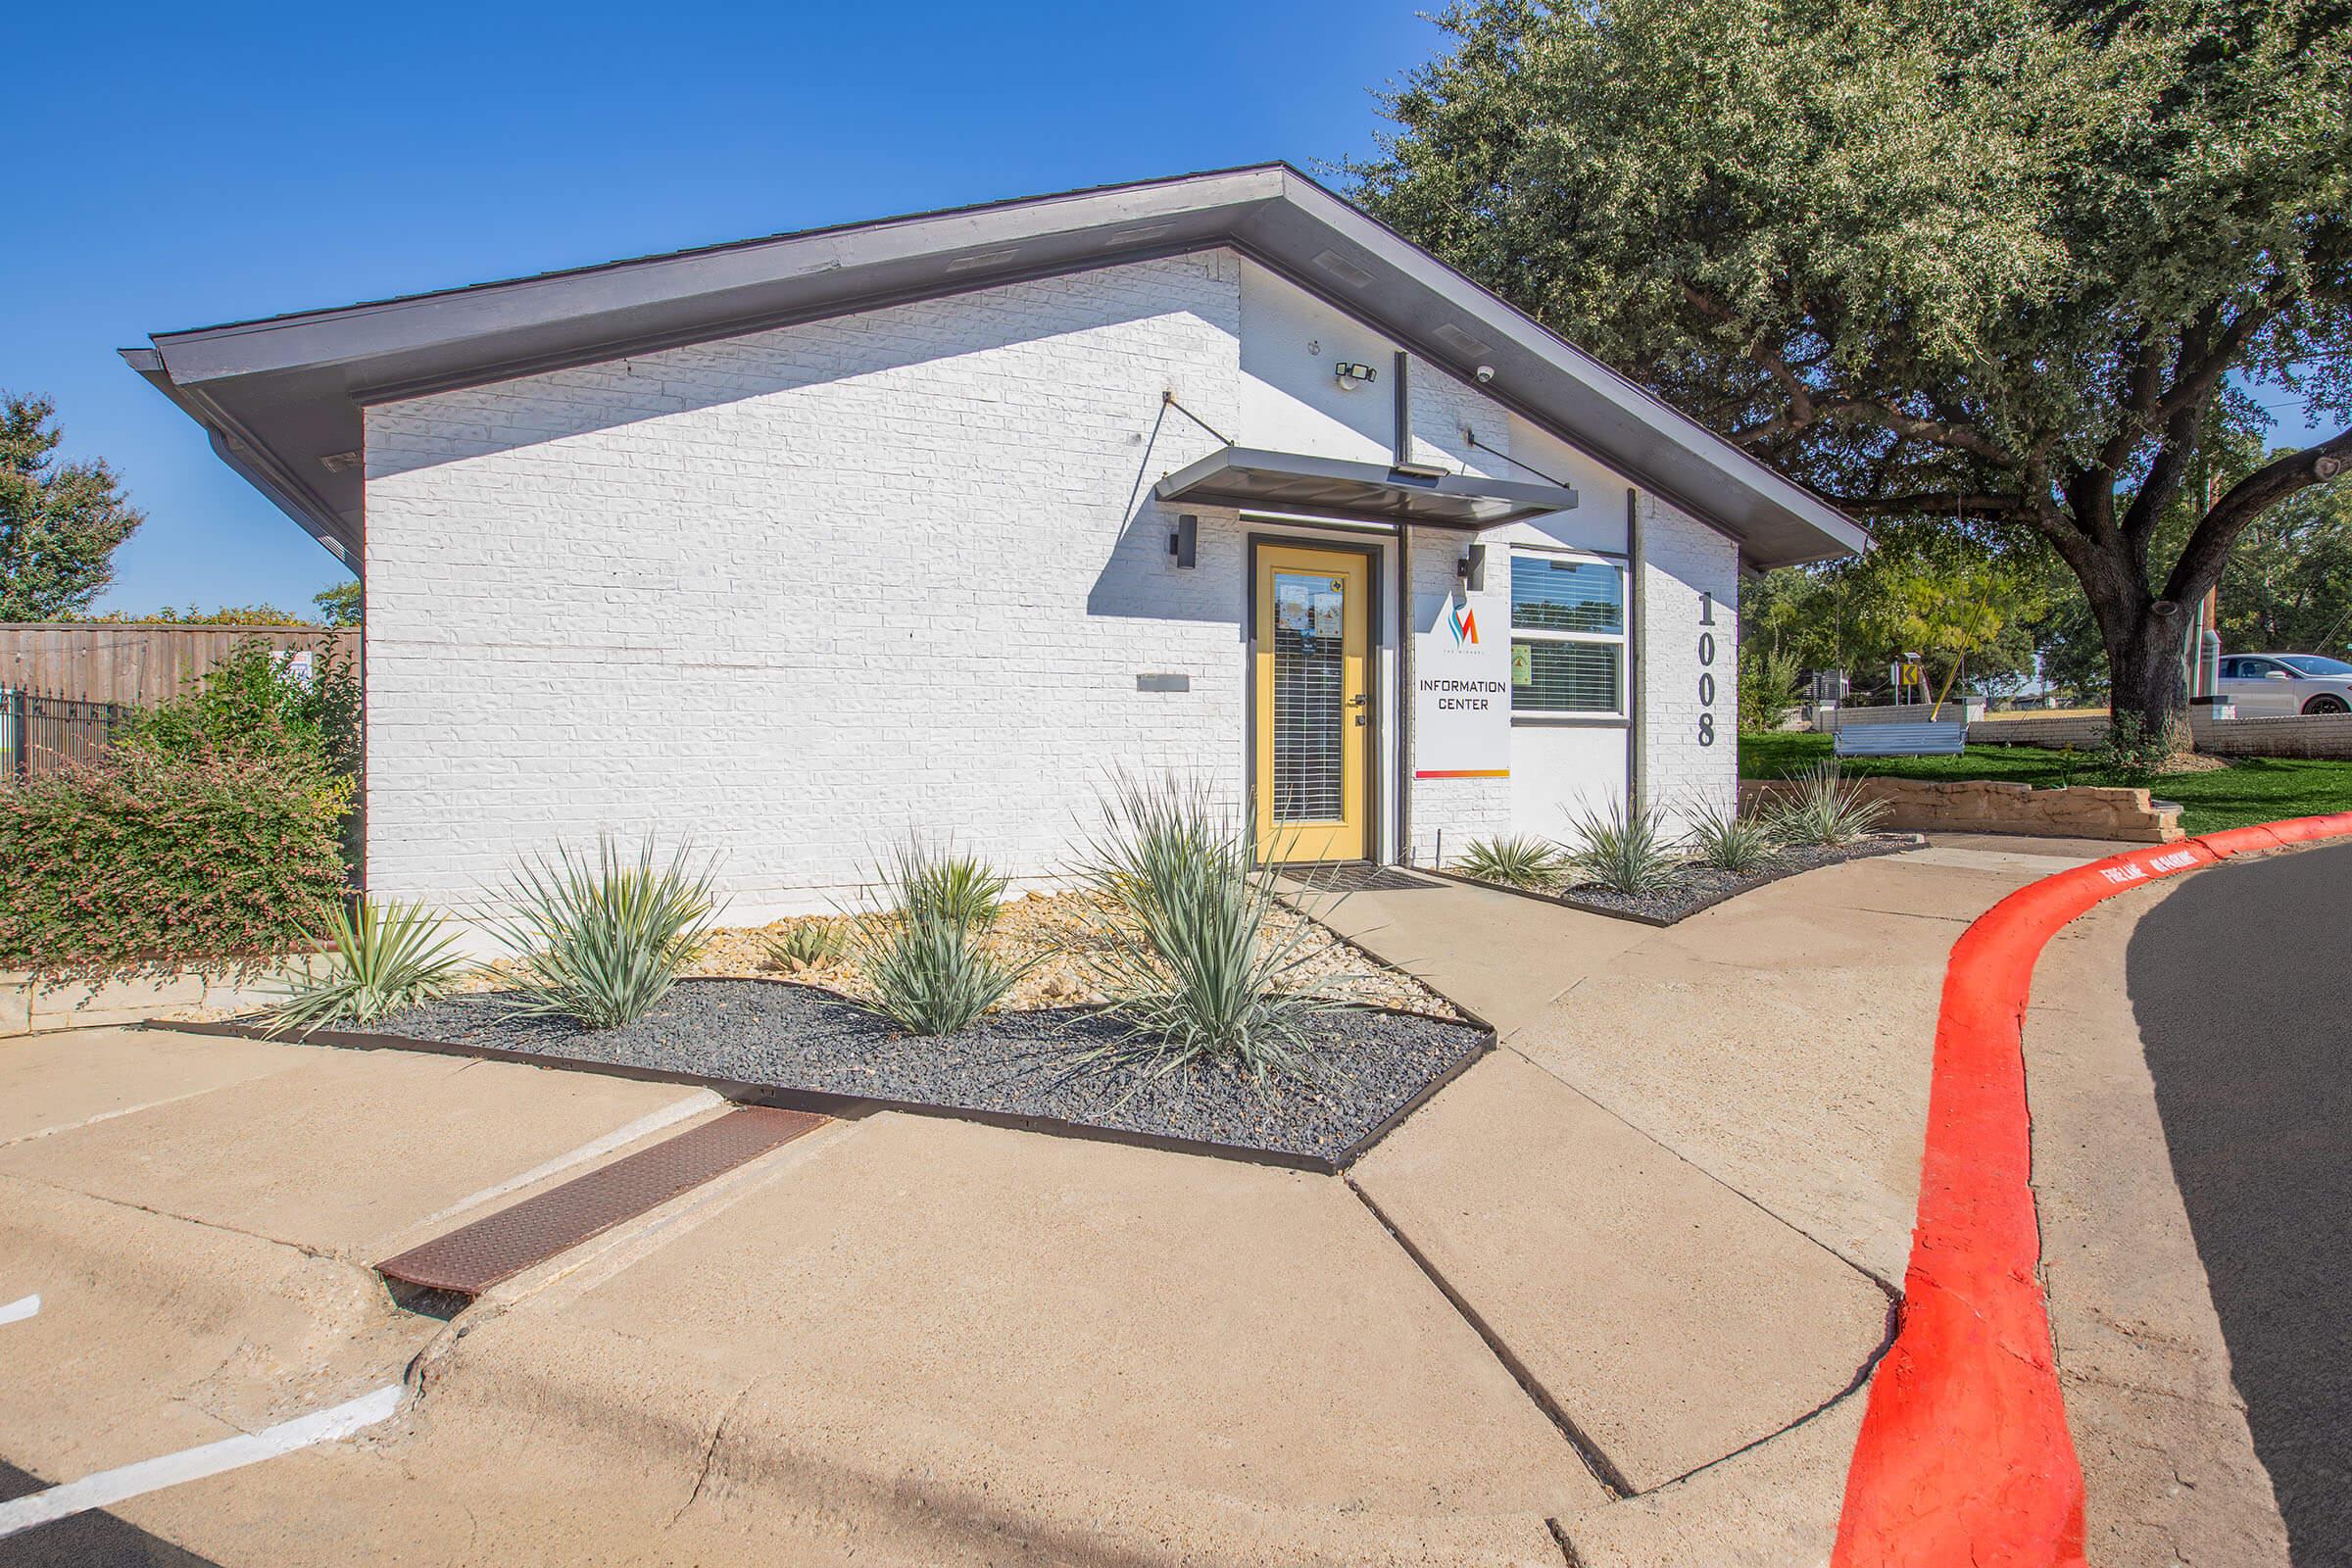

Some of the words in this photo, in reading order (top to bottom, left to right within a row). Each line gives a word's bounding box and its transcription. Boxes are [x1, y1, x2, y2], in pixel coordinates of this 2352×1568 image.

[1698, 591, 1716, 747] 1008
[1420, 679, 1506, 693] INFORMATION
[1439, 698, 1489, 710] CENTER
